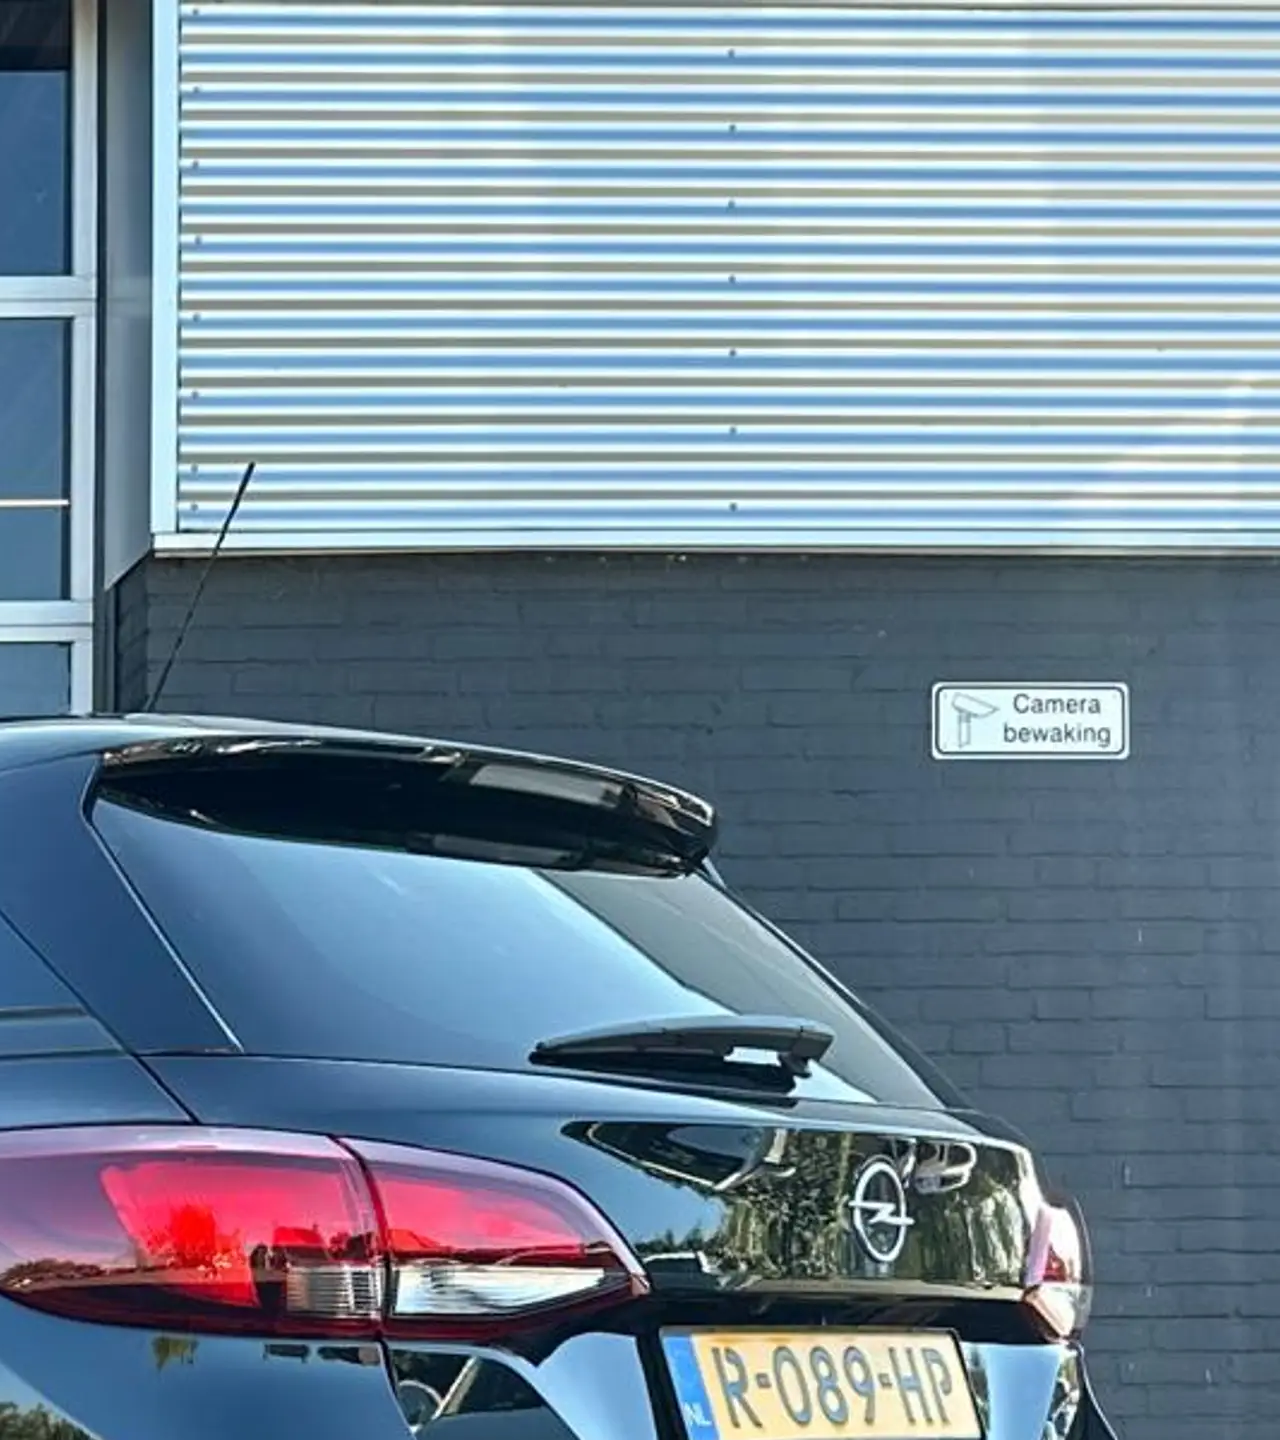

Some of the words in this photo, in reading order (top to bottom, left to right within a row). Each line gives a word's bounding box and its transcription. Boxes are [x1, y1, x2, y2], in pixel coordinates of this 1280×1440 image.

[1013, 693, 1101, 714] Camera
[1004, 722, 1111, 748] bewaking
[711, 1345, 952, 1429] R-089-HP
[683, 1402, 712, 1426] NL
